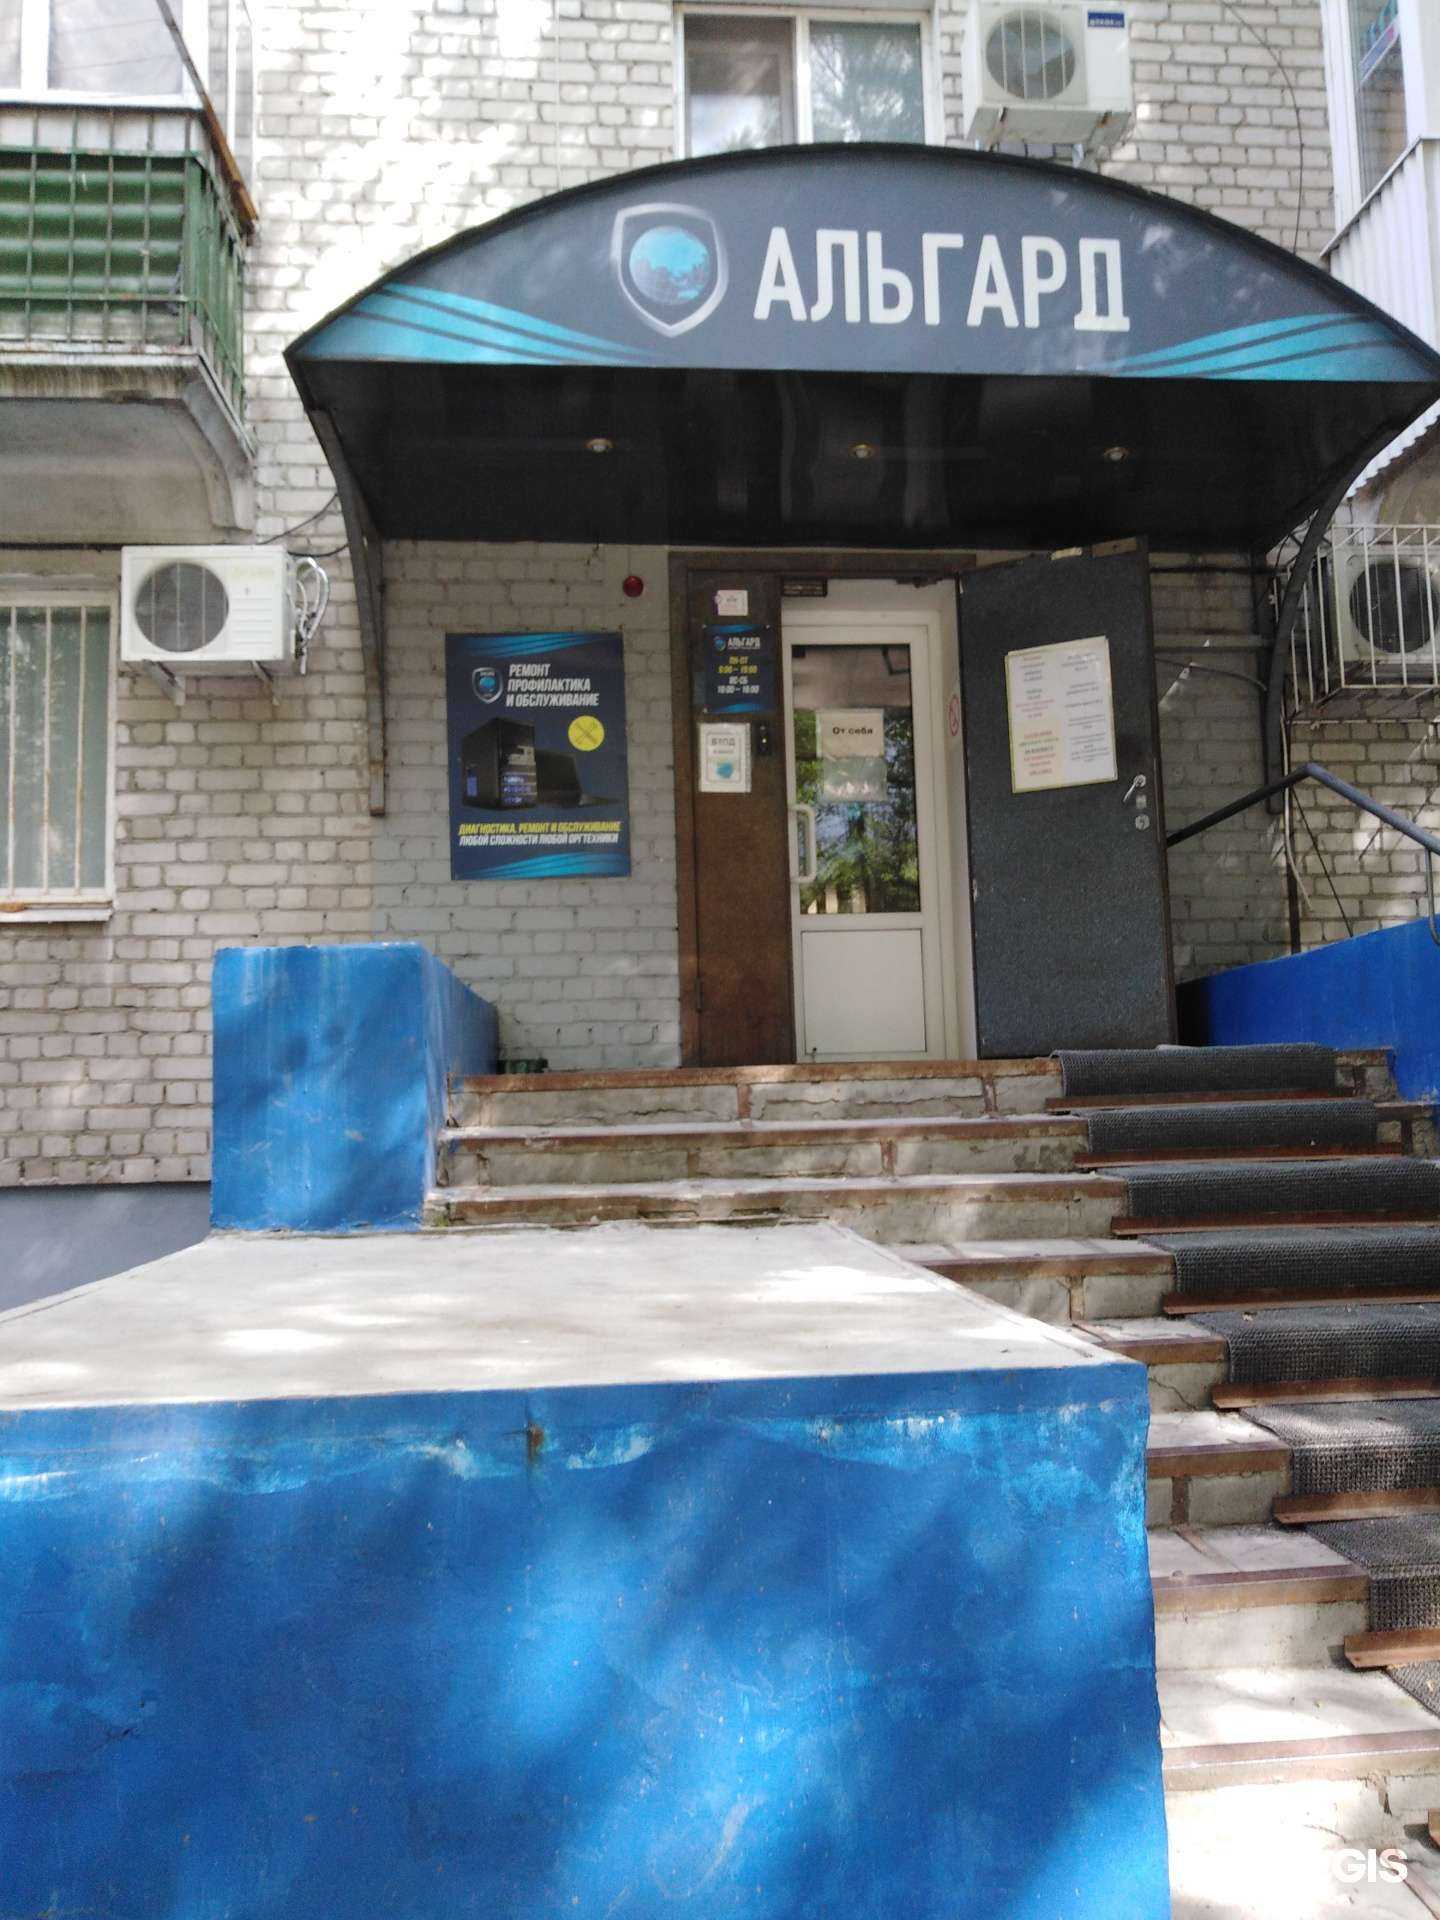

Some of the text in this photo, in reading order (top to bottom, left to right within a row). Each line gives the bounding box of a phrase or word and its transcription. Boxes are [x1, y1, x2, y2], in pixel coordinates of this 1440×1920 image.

[753, 226, 1130, 332] АЛЬГАРД
[727, 637, 760, 648] АЛЬГАРД
[508, 664, 551, 677] РЕМОНТ
[507, 678, 592, 692] ПРОФИЛАКТИКА
[506, 693, 600, 707] И ОБСЛУЖИВАНИЕ
[832, 726, 873, 735] От себя
[518, 822, 550, 833] РЕМОНТ
[550, 822, 558, 832] И
[558, 821, 621, 833] ОБСЛУЖИВАНИЕ
[459, 832, 619, 846] ЛЮБОЙ СЛОЖНОСТИ ЛЮБОЙ ОРГТЕХНИКИ
